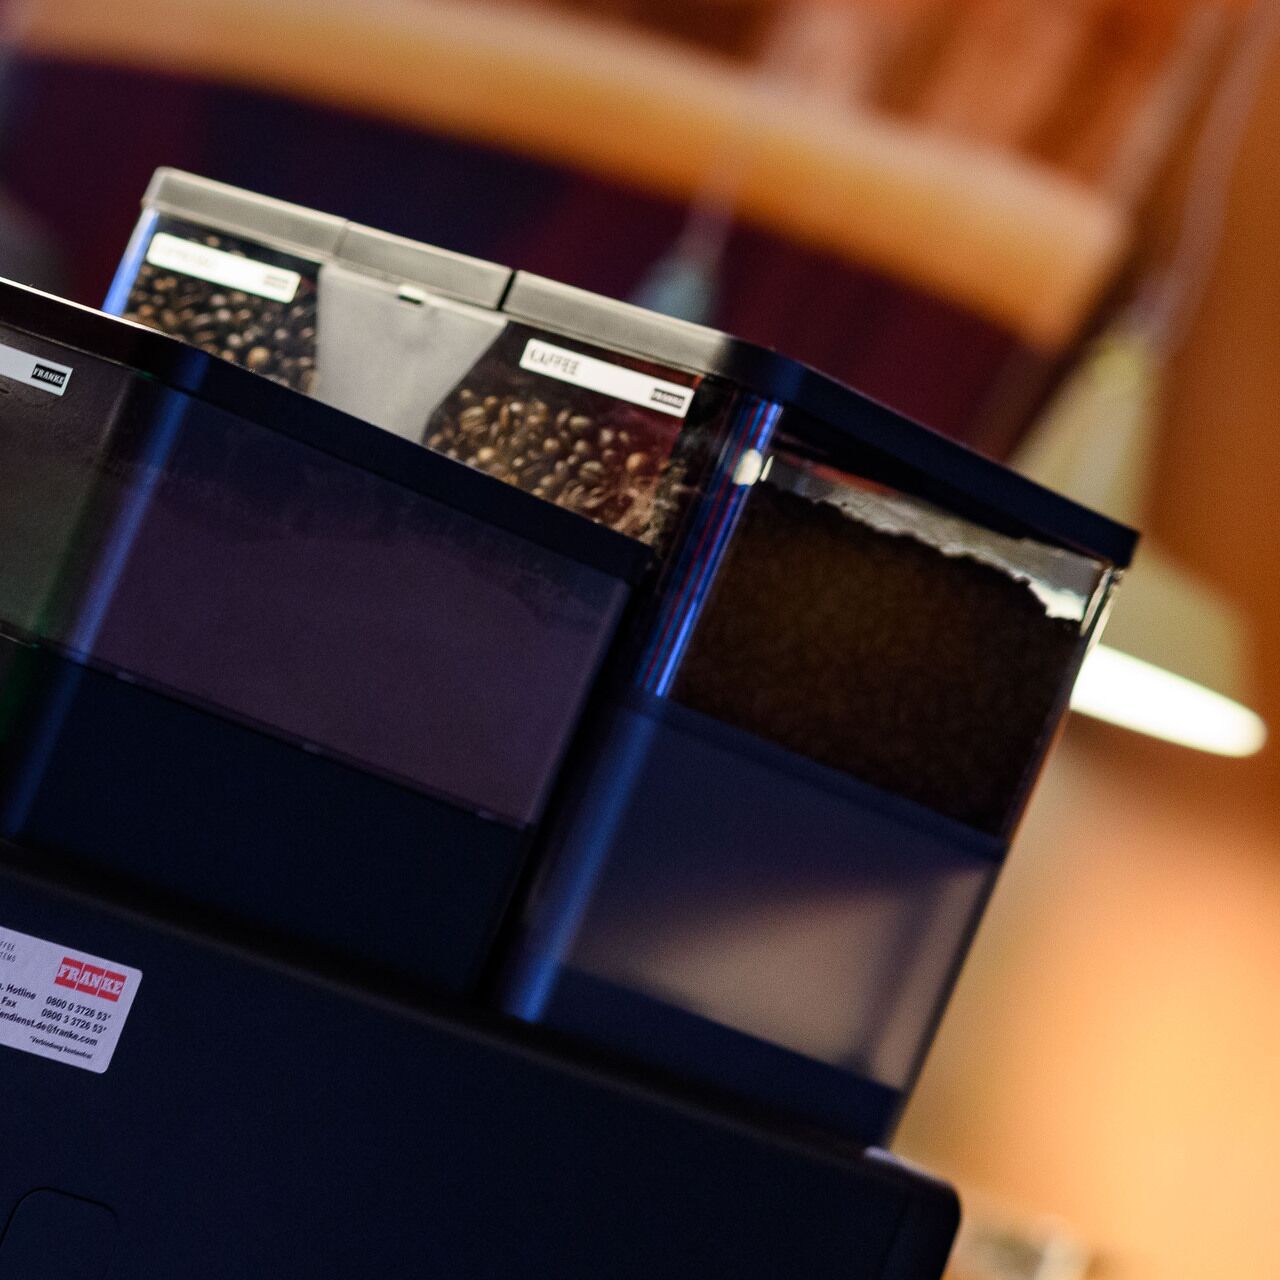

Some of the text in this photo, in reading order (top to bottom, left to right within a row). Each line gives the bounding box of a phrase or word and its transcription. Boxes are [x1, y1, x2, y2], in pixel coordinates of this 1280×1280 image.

[32, 365, 66, 386] FRANKE
[56, 963, 124, 996] FRANKE
[0, 996, 18, 1009] Fax
[40, 1007, 62, 1022] 0800
[6, 983, 37, 1000] Hotline
[46, 995, 68, 1010] 0800
